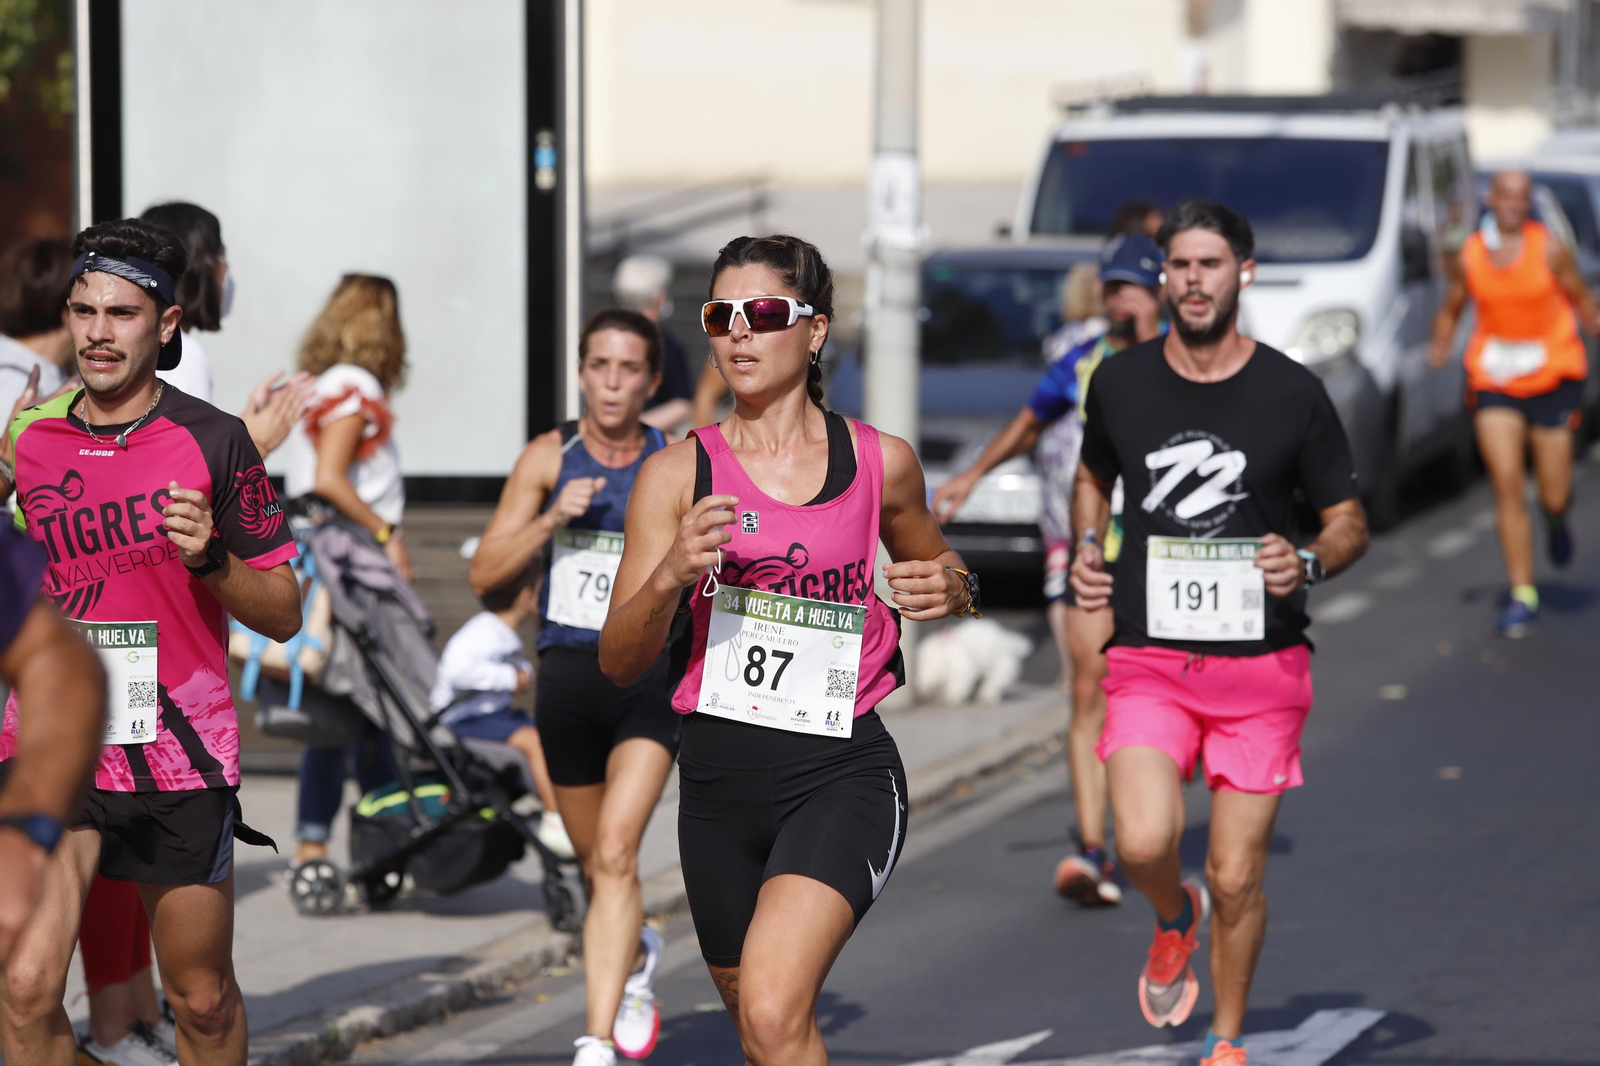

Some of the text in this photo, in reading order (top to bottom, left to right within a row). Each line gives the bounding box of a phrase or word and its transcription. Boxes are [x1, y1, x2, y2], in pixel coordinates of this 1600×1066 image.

[79, 449, 115, 457] CEJUDO
[1141, 439, 1249, 519] 72
[263, 502, 283, 517] VAL
[37, 488, 174, 564] TIGRES
[56, 541, 179, 588] VALVERDE
[578, 571, 610, 602] 79
[1170, 581, 1218, 611] 191
[724, 594, 853, 630] 34 VUELTA A HUELVA
[98, 629, 146, 645] HUELVA
[741, 630, 799, 647] PEREZ MULERO
[753, 622, 785, 636] IRENE
[743, 645, 794, 691] 87
[748, 691, 797, 706] INDEPENDIENTE
